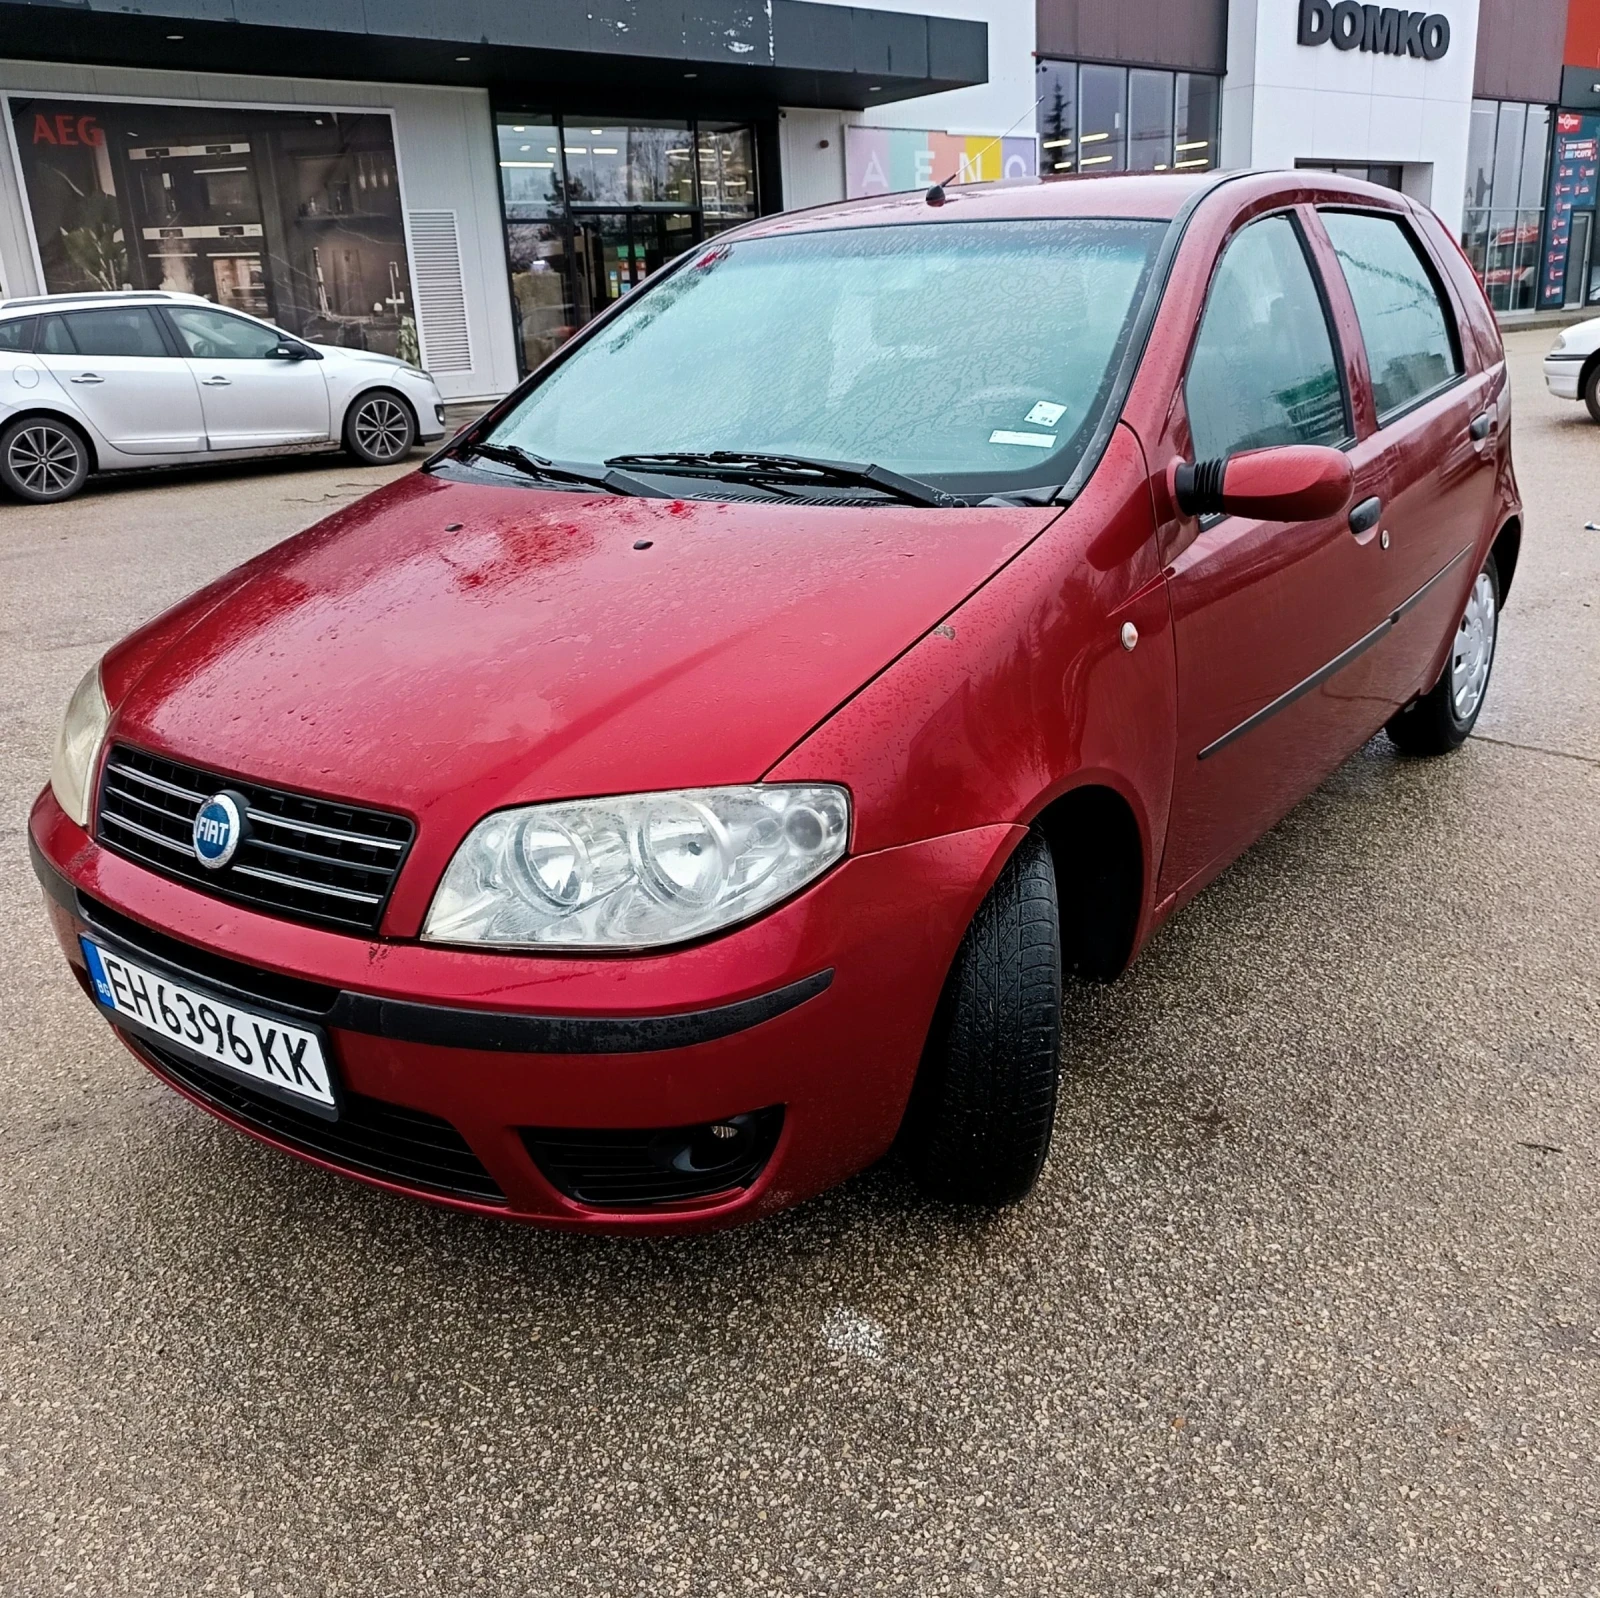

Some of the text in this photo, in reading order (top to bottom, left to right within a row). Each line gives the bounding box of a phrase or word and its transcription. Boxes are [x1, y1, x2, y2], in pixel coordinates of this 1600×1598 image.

[1297, 0, 1450, 61] DOMKO
[32, 112, 105, 146] AEG
[197, 816, 229, 846] FIAT
[96, 979, 110, 997] BG
